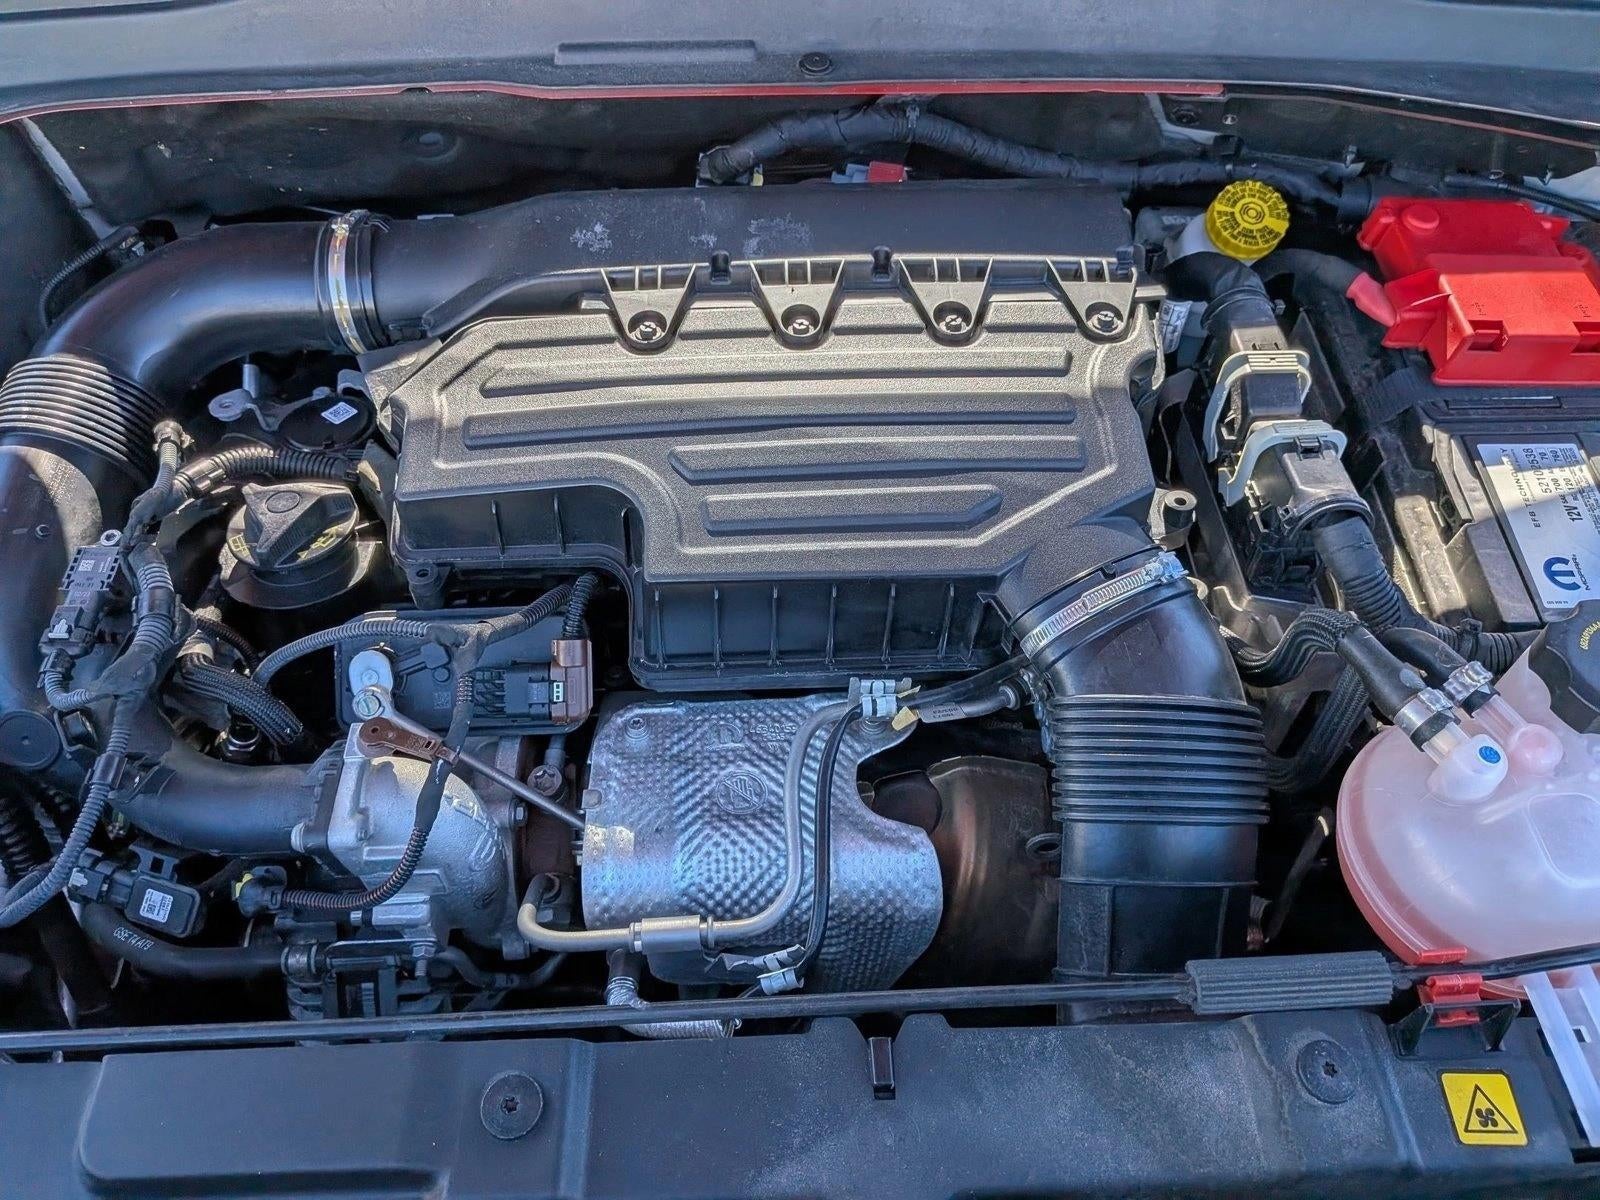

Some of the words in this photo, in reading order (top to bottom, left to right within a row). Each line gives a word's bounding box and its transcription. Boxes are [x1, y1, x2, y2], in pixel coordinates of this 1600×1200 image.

[1539, 451, 1549, 461] 70
[1549, 449, 1561, 463] 760
[1522, 447, 1552, 494] 52102538
[1550, 477, 1563, 491] 700
[1563, 477, 1575, 491] 120
[1528, 510, 1541, 528] EFB
[1563, 505, 1584, 522] 12V
